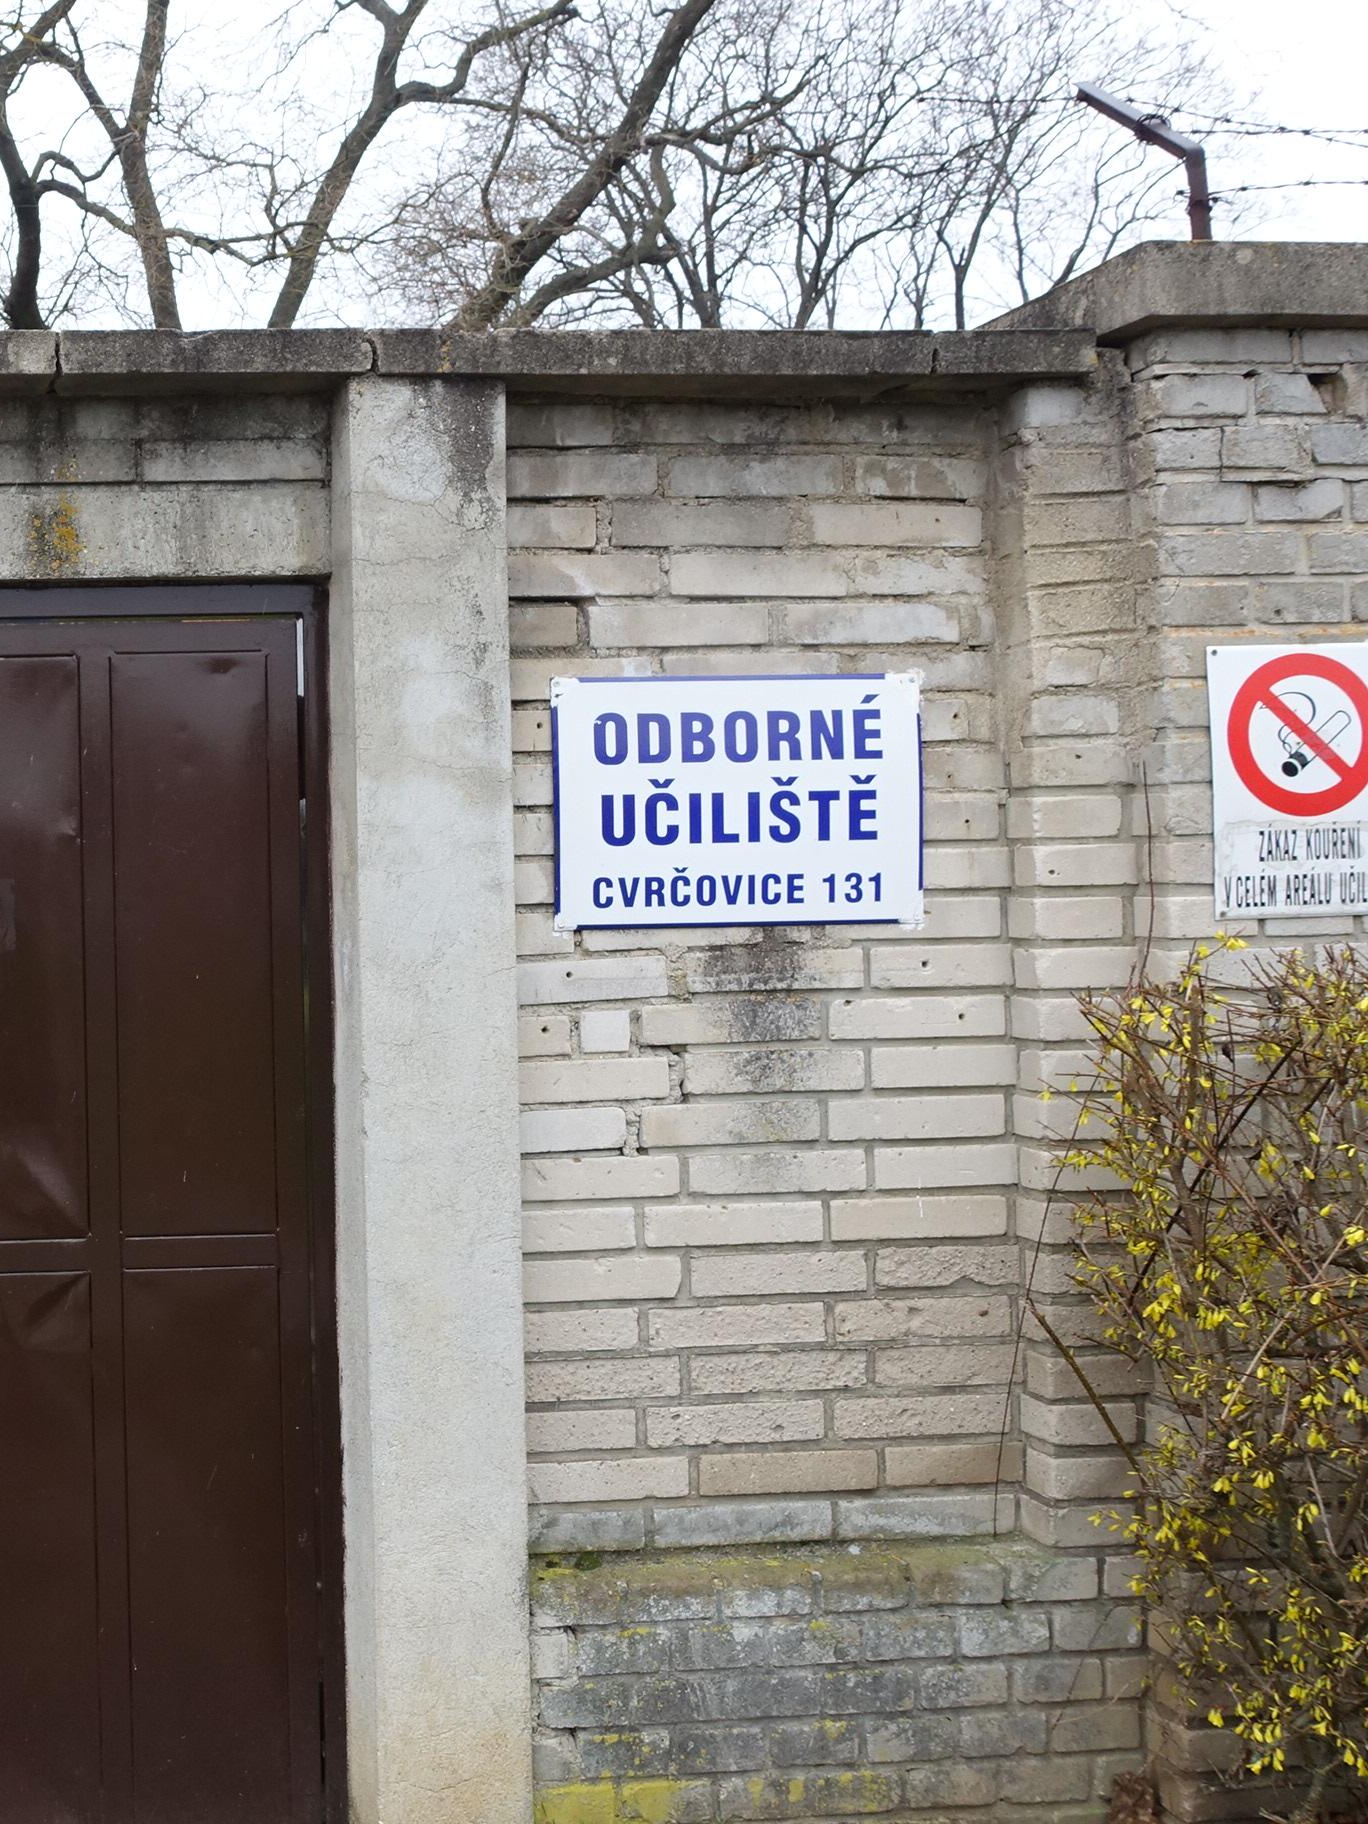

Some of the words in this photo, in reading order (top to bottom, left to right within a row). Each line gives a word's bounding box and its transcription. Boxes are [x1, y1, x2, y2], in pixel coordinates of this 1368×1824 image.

[593, 694, 883, 766] ODBORNÉ
[601, 774, 879, 847] UČILIŠTĚ
[1258, 823, 1298, 862] ZÁKAZ
[1305, 820, 1361, 860] KOUŘENÍ
[593, 867, 805, 909] CVRČOVICE
[822, 872, 883, 904] 131
[1236, 868, 1277, 908] CELÉM
[1285, 866, 1332, 906] AREÁLU
